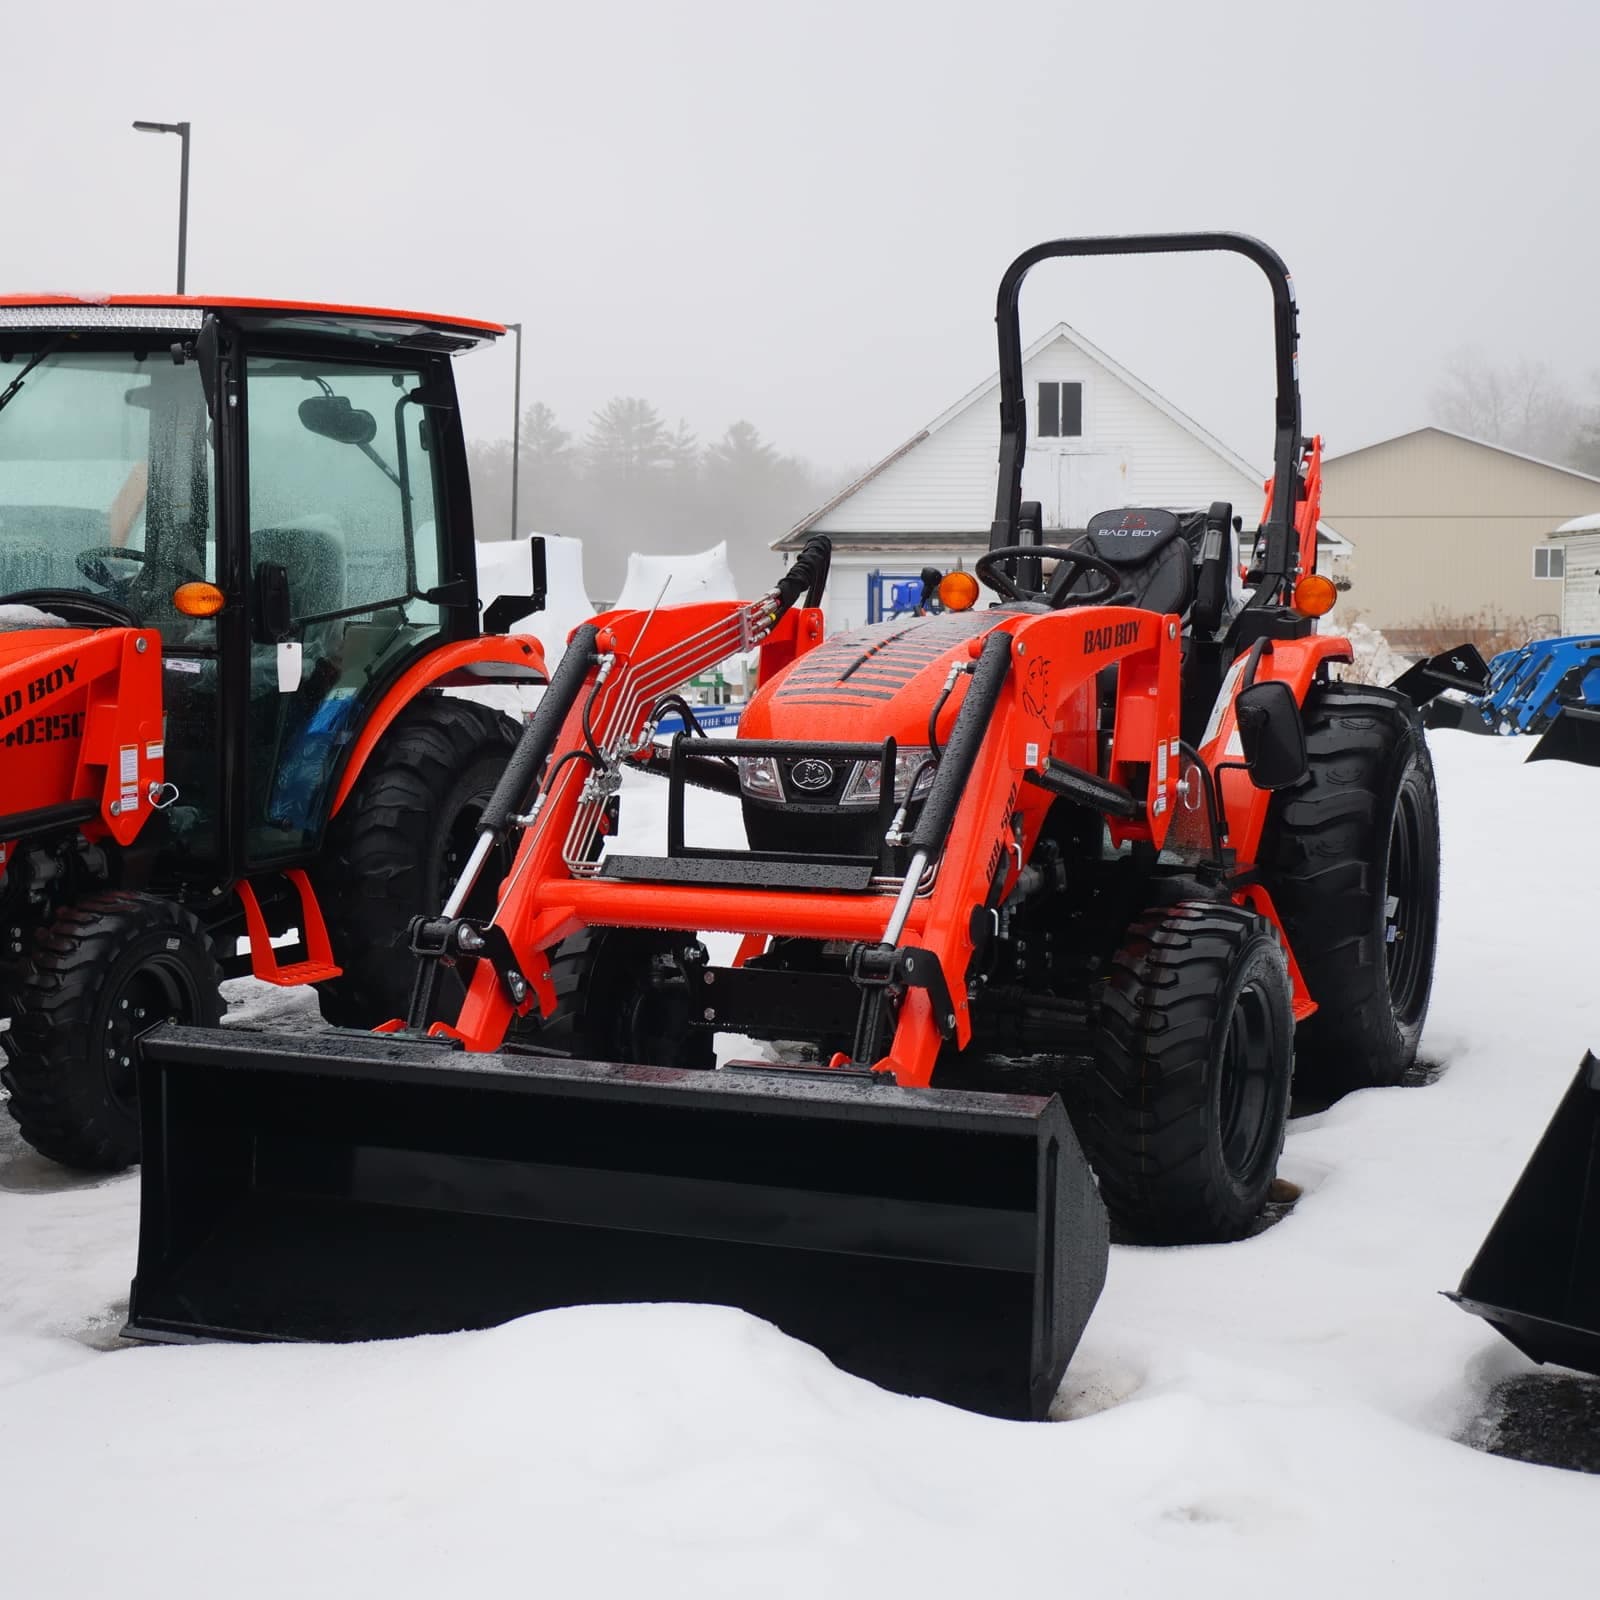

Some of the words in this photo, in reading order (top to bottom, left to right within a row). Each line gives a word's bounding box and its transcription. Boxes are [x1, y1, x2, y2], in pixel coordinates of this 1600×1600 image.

[1098, 529, 1128, 537] BAD
[1131, 529, 1162, 537] BOY
[1083, 625, 1113, 655] BAD
[1114, 619, 1141, 648] BOY
[0, 690, 22, 720] D
[27, 658, 79, 704] BOY
